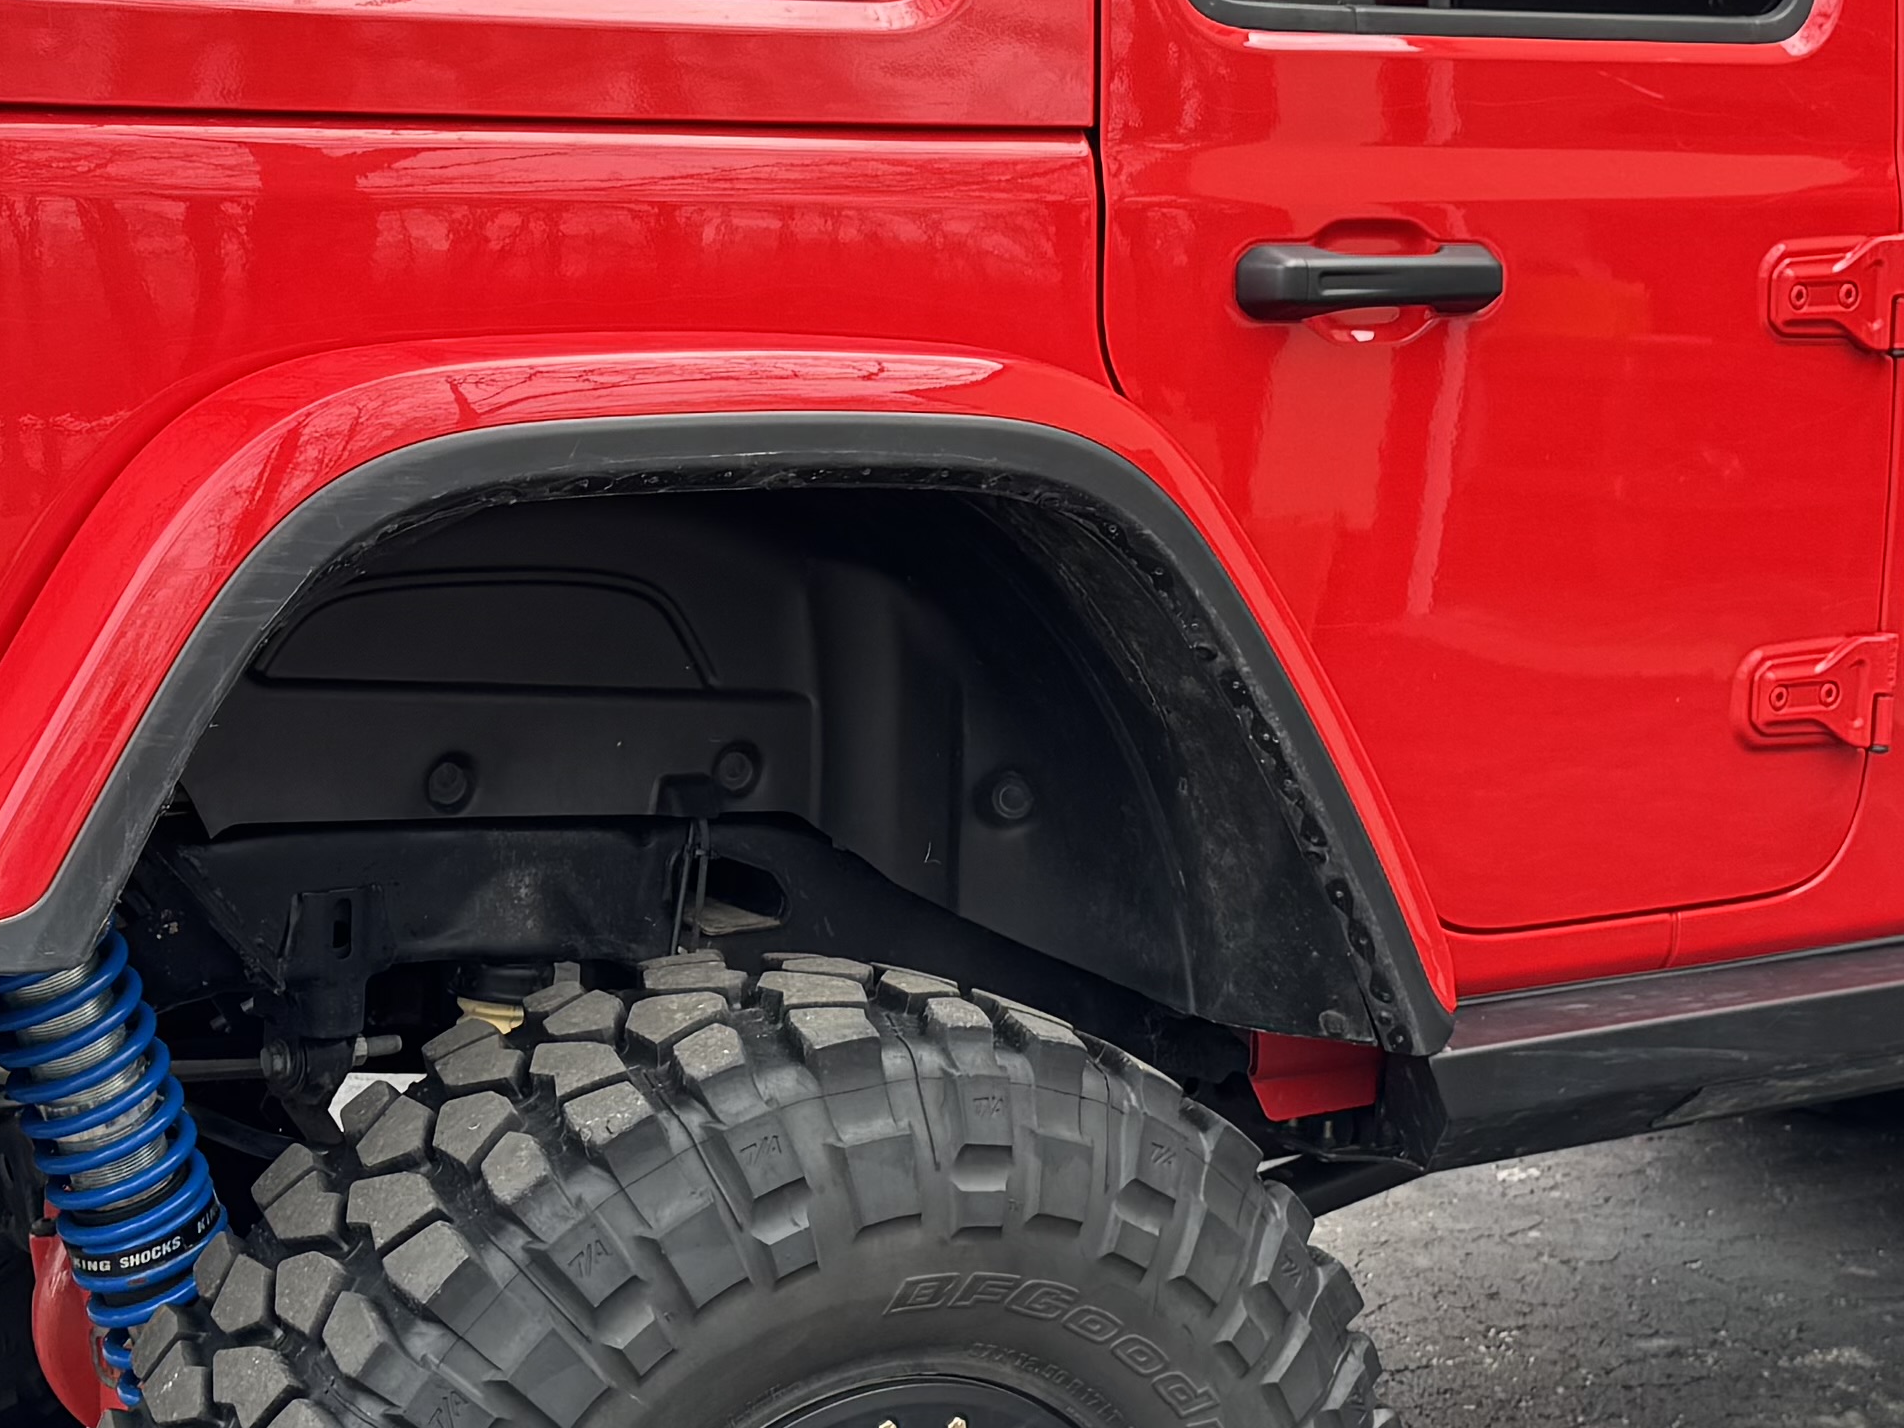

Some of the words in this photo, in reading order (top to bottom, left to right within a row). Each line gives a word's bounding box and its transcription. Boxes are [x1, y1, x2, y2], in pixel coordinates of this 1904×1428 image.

[739, 1133, 783, 1167] T/A
[72, 1258, 112, 1273] KING
[119, 1235, 183, 1270] SHOCKS
[567, 1238, 613, 1278] T/A
